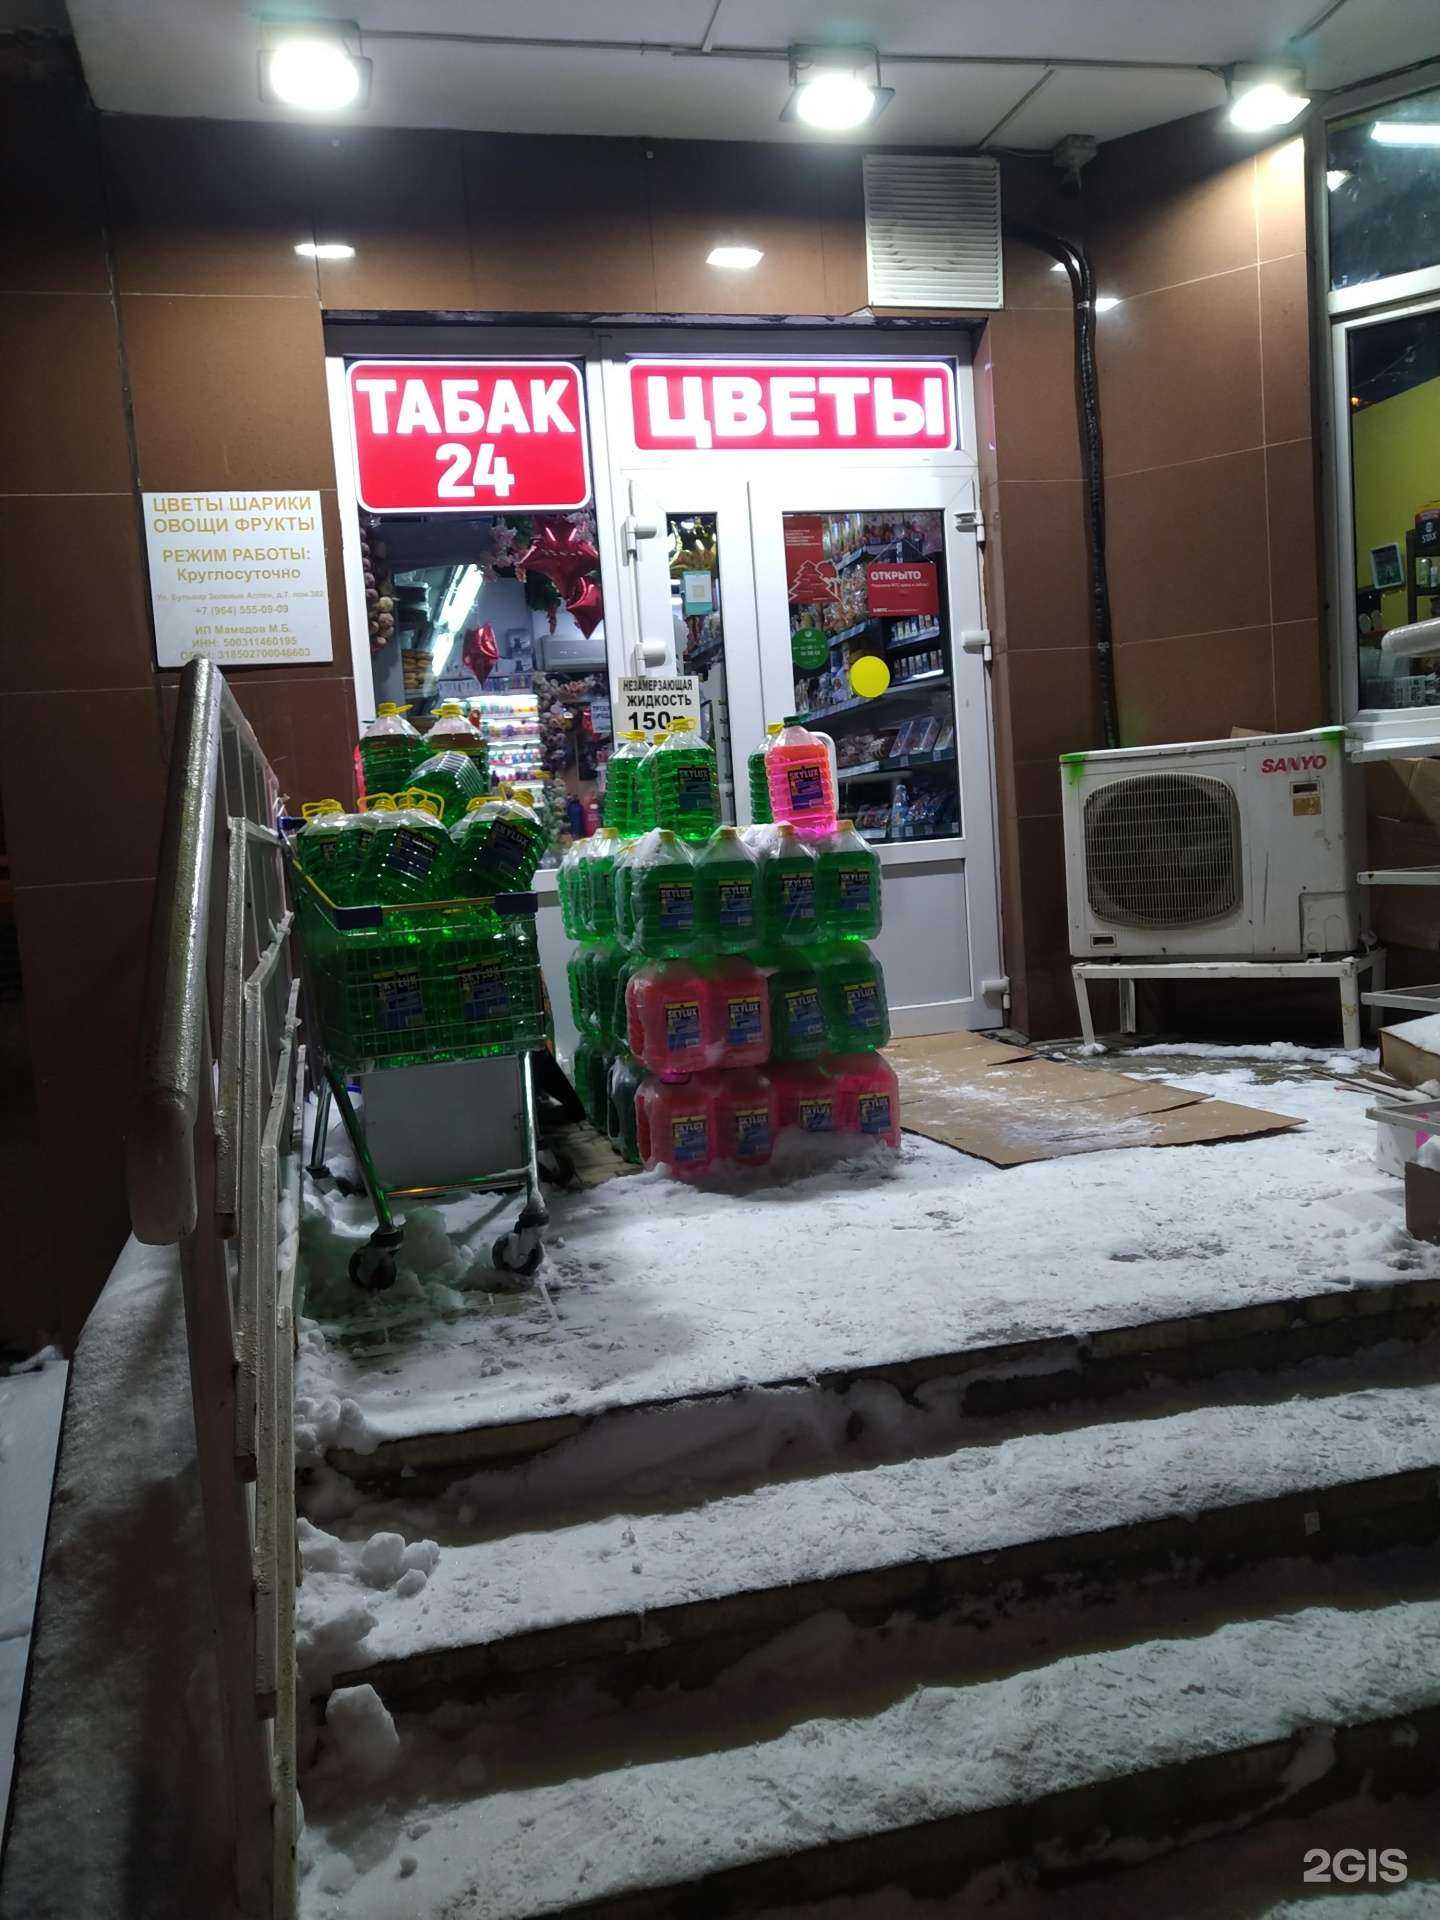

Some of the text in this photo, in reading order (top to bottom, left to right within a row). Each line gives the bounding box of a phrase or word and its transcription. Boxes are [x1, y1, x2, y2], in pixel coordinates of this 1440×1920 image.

[355, 379, 576, 434] ТАБАК
[648, 376, 946, 449] ЦВЕТЫ
[435, 442, 516, 498] 24
[153, 497, 311, 514] ЦВЕТЫ ШАРИКИ
[154, 517, 315, 534] ОВОЩИ ФРУКТЫ
[163, 548, 310, 562] РЕЖИМ РАБОТЫ:
[177, 568, 300, 583] Круглосуточно
[871, 571, 921, 580] ОТКРЫТО
[623, 680, 693, 691] НЕЗАМЕРЗАЮЩАЯ
[627, 694, 692, 707] ЖИДКОСТЬ
[1261, 755, 1327, 773] SANYO
